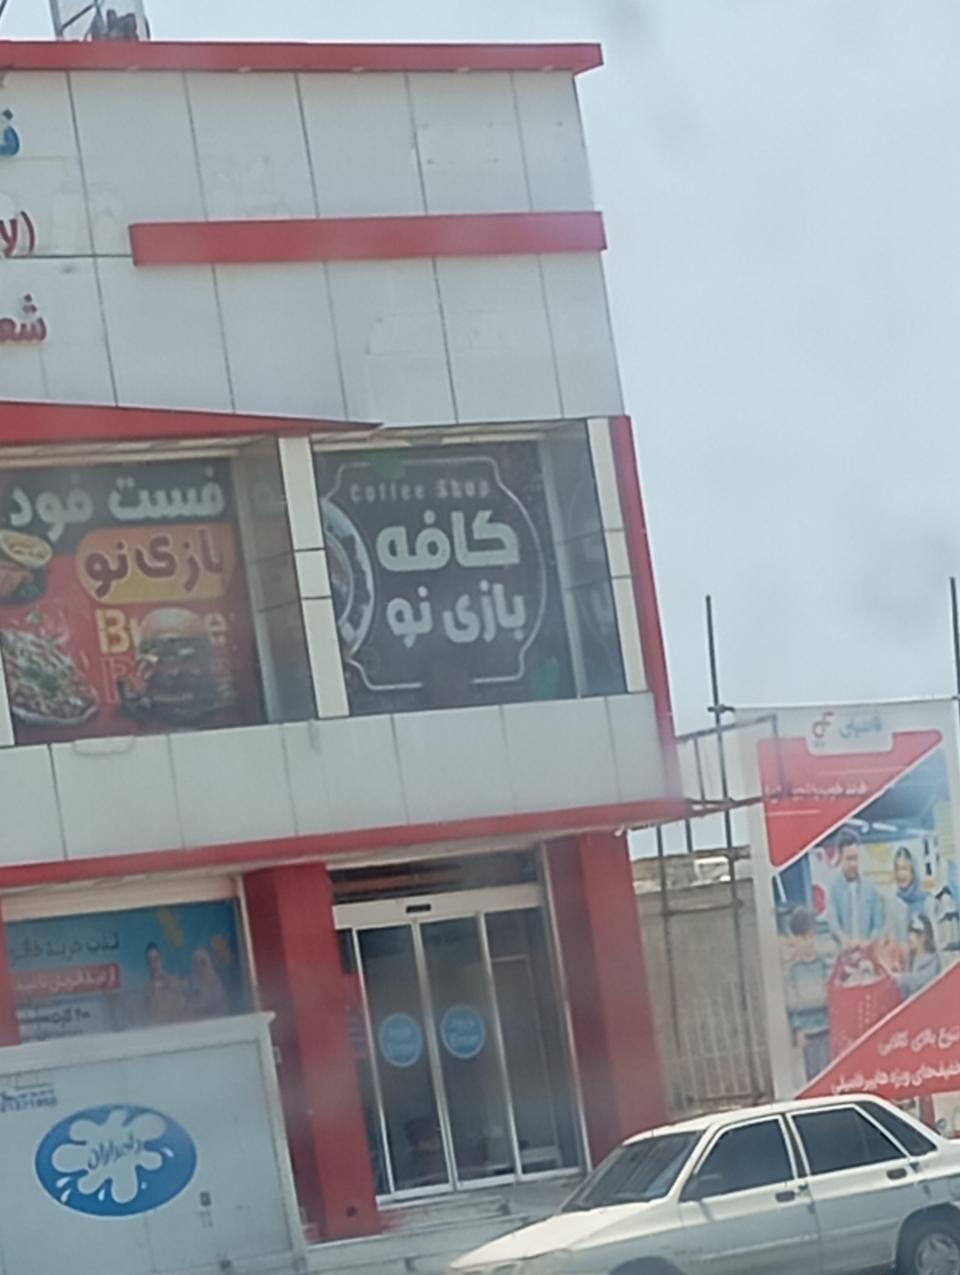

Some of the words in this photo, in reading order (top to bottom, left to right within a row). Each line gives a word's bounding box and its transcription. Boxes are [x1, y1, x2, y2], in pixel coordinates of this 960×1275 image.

[8, 476, 94, 542] فود
[108, 466, 226, 521] فست
[84, 539, 130, 599] نو
[375, 509, 521, 572] کافه
[386, 585, 434, 648] نو
[443, 579, 527, 644] بازی
